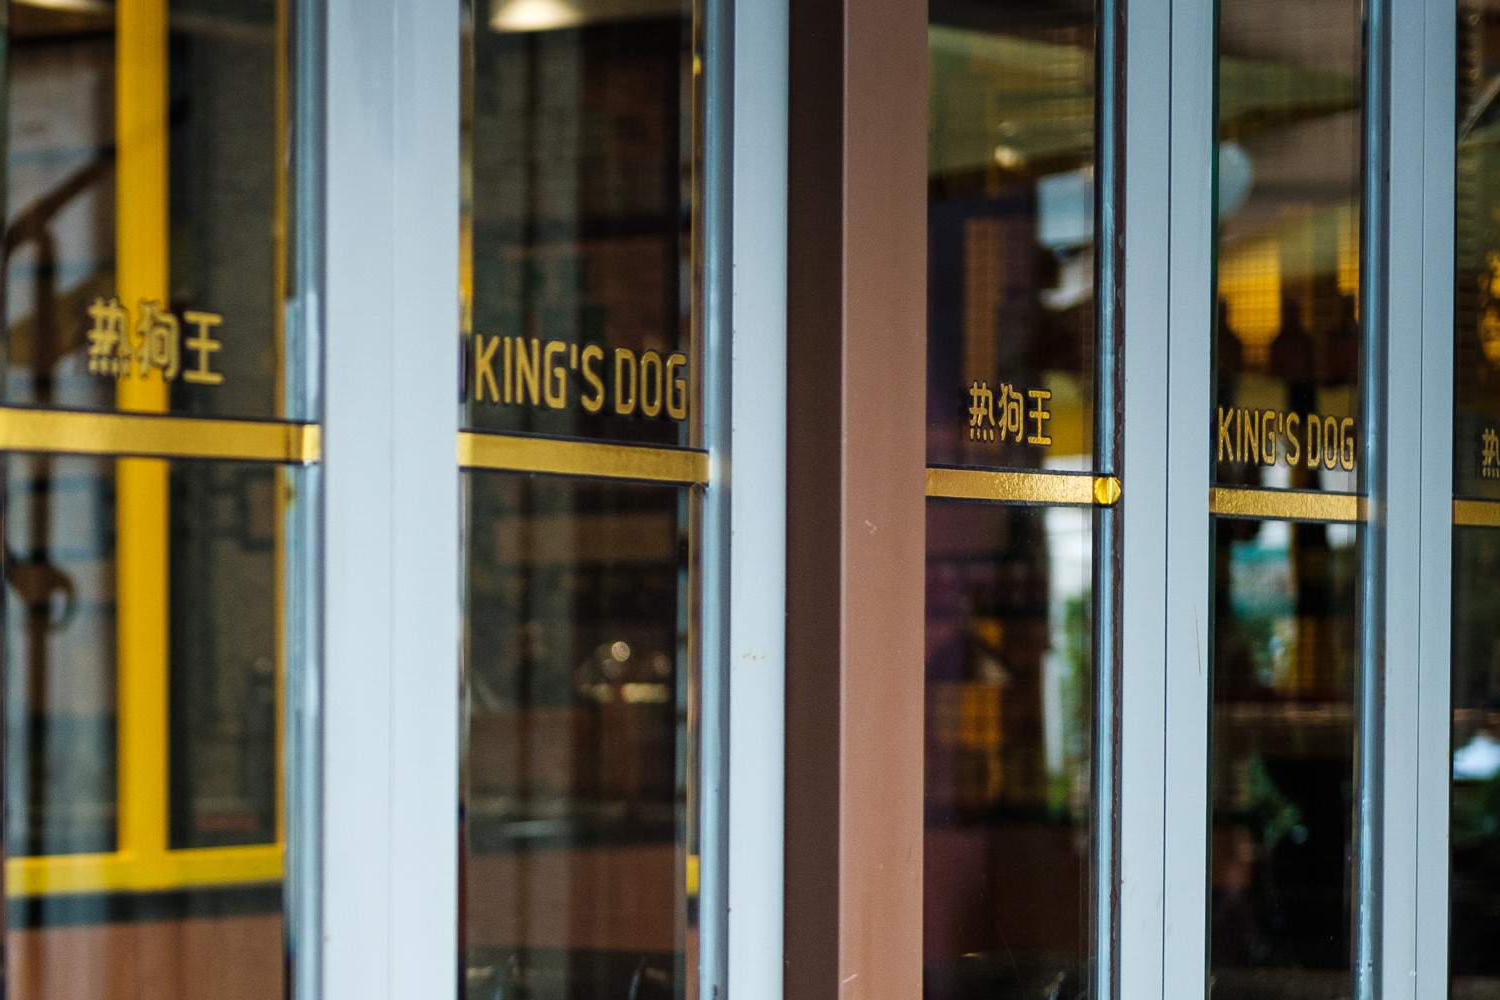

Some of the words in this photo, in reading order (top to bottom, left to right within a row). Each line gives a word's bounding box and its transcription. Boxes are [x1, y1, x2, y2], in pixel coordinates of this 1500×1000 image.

[87, 297, 224, 386] 热狗王
[474, 333, 605, 413] KING'S
[613, 346, 688, 420] DOG
[968, 380, 1053, 446] 热狗王
[1217, 406, 1301, 467] KING'S
[1306, 414, 1355, 471] DOG
